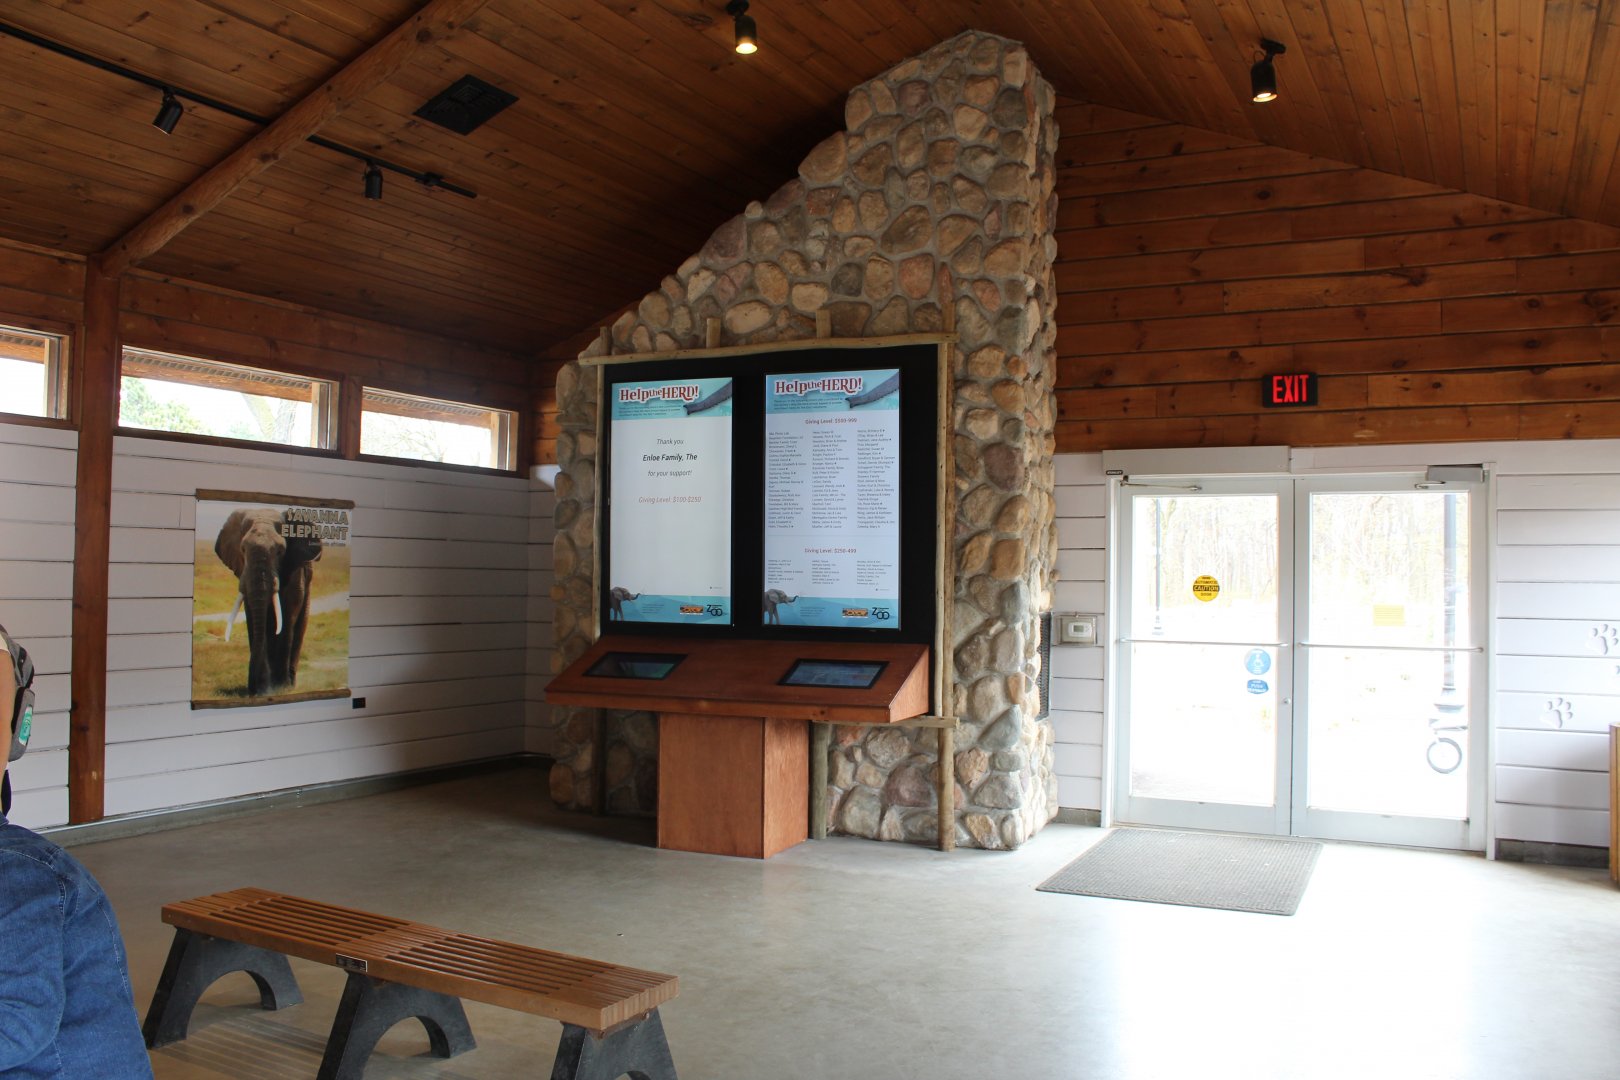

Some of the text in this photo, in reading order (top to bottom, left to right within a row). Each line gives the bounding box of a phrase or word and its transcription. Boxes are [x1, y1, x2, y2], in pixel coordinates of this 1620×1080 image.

[620, 385, 699, 402] Help the HERD!
[776, 377, 862, 394] Help the HERD!
[1272, 374, 1309, 403] EXIT
[661, 453, 684, 462] Family,
[686, 453, 698, 461] The
[638, 496, 655, 504] Giving
[286, 507, 349, 525] SAVANNA
[281, 523, 349, 540] ELEPHANT
